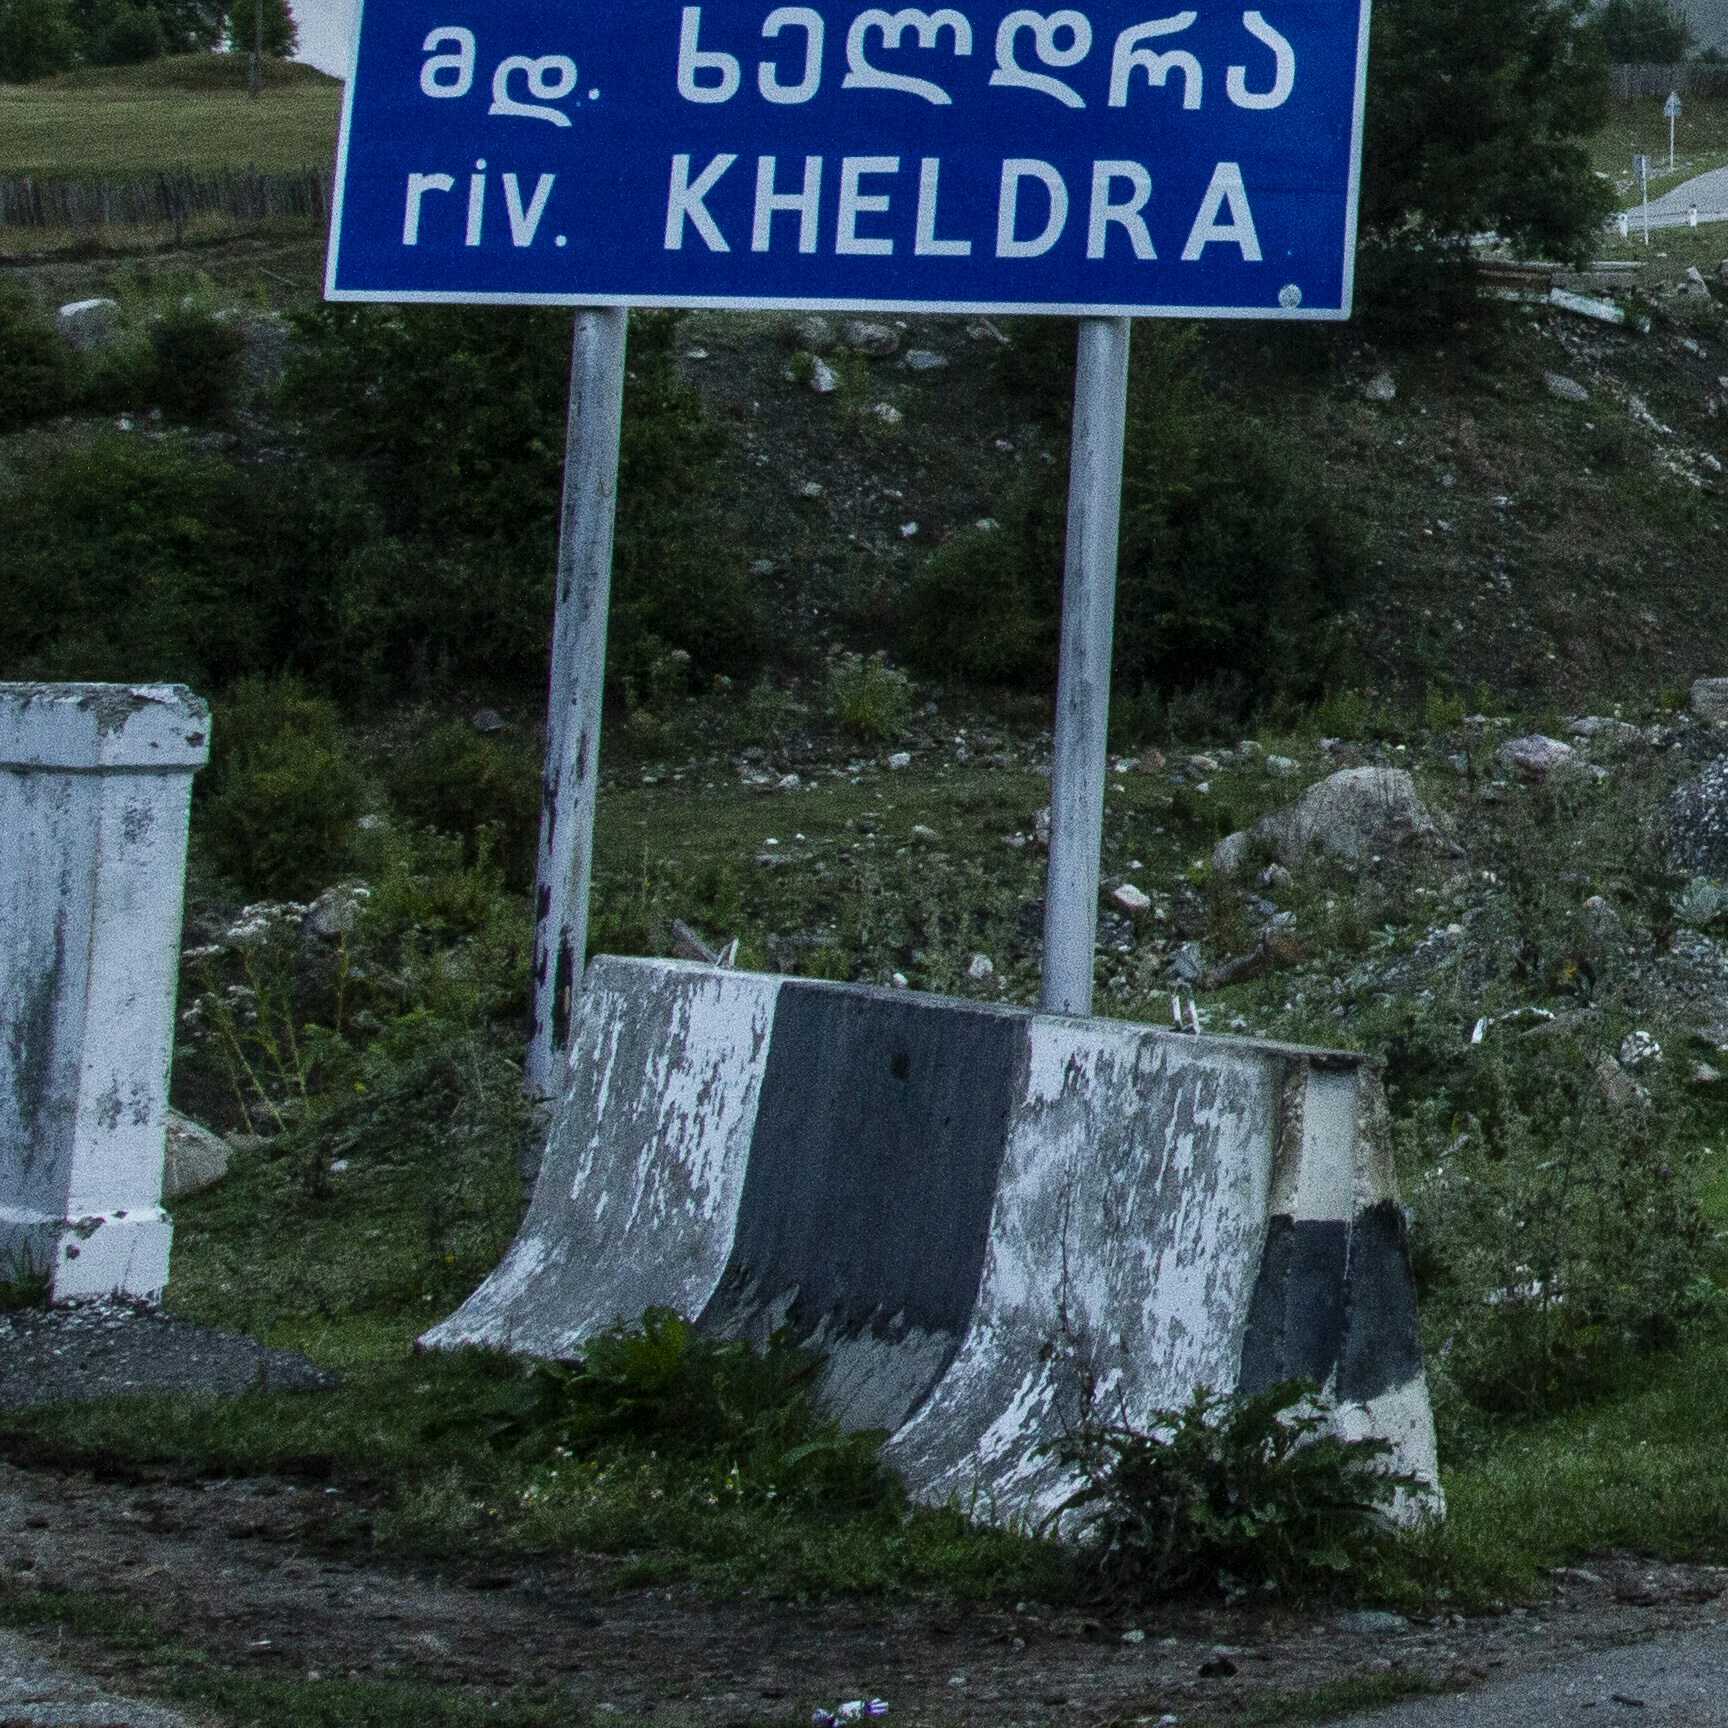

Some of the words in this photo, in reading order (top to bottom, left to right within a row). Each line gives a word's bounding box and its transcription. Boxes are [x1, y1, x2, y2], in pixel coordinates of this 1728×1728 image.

[419, 26, 600, 127] მდ.
[677, 6, 1296, 110] ხელდრა
[402, 158, 567, 247] riv.
[663, 154, 1263, 262] KHELDRA
